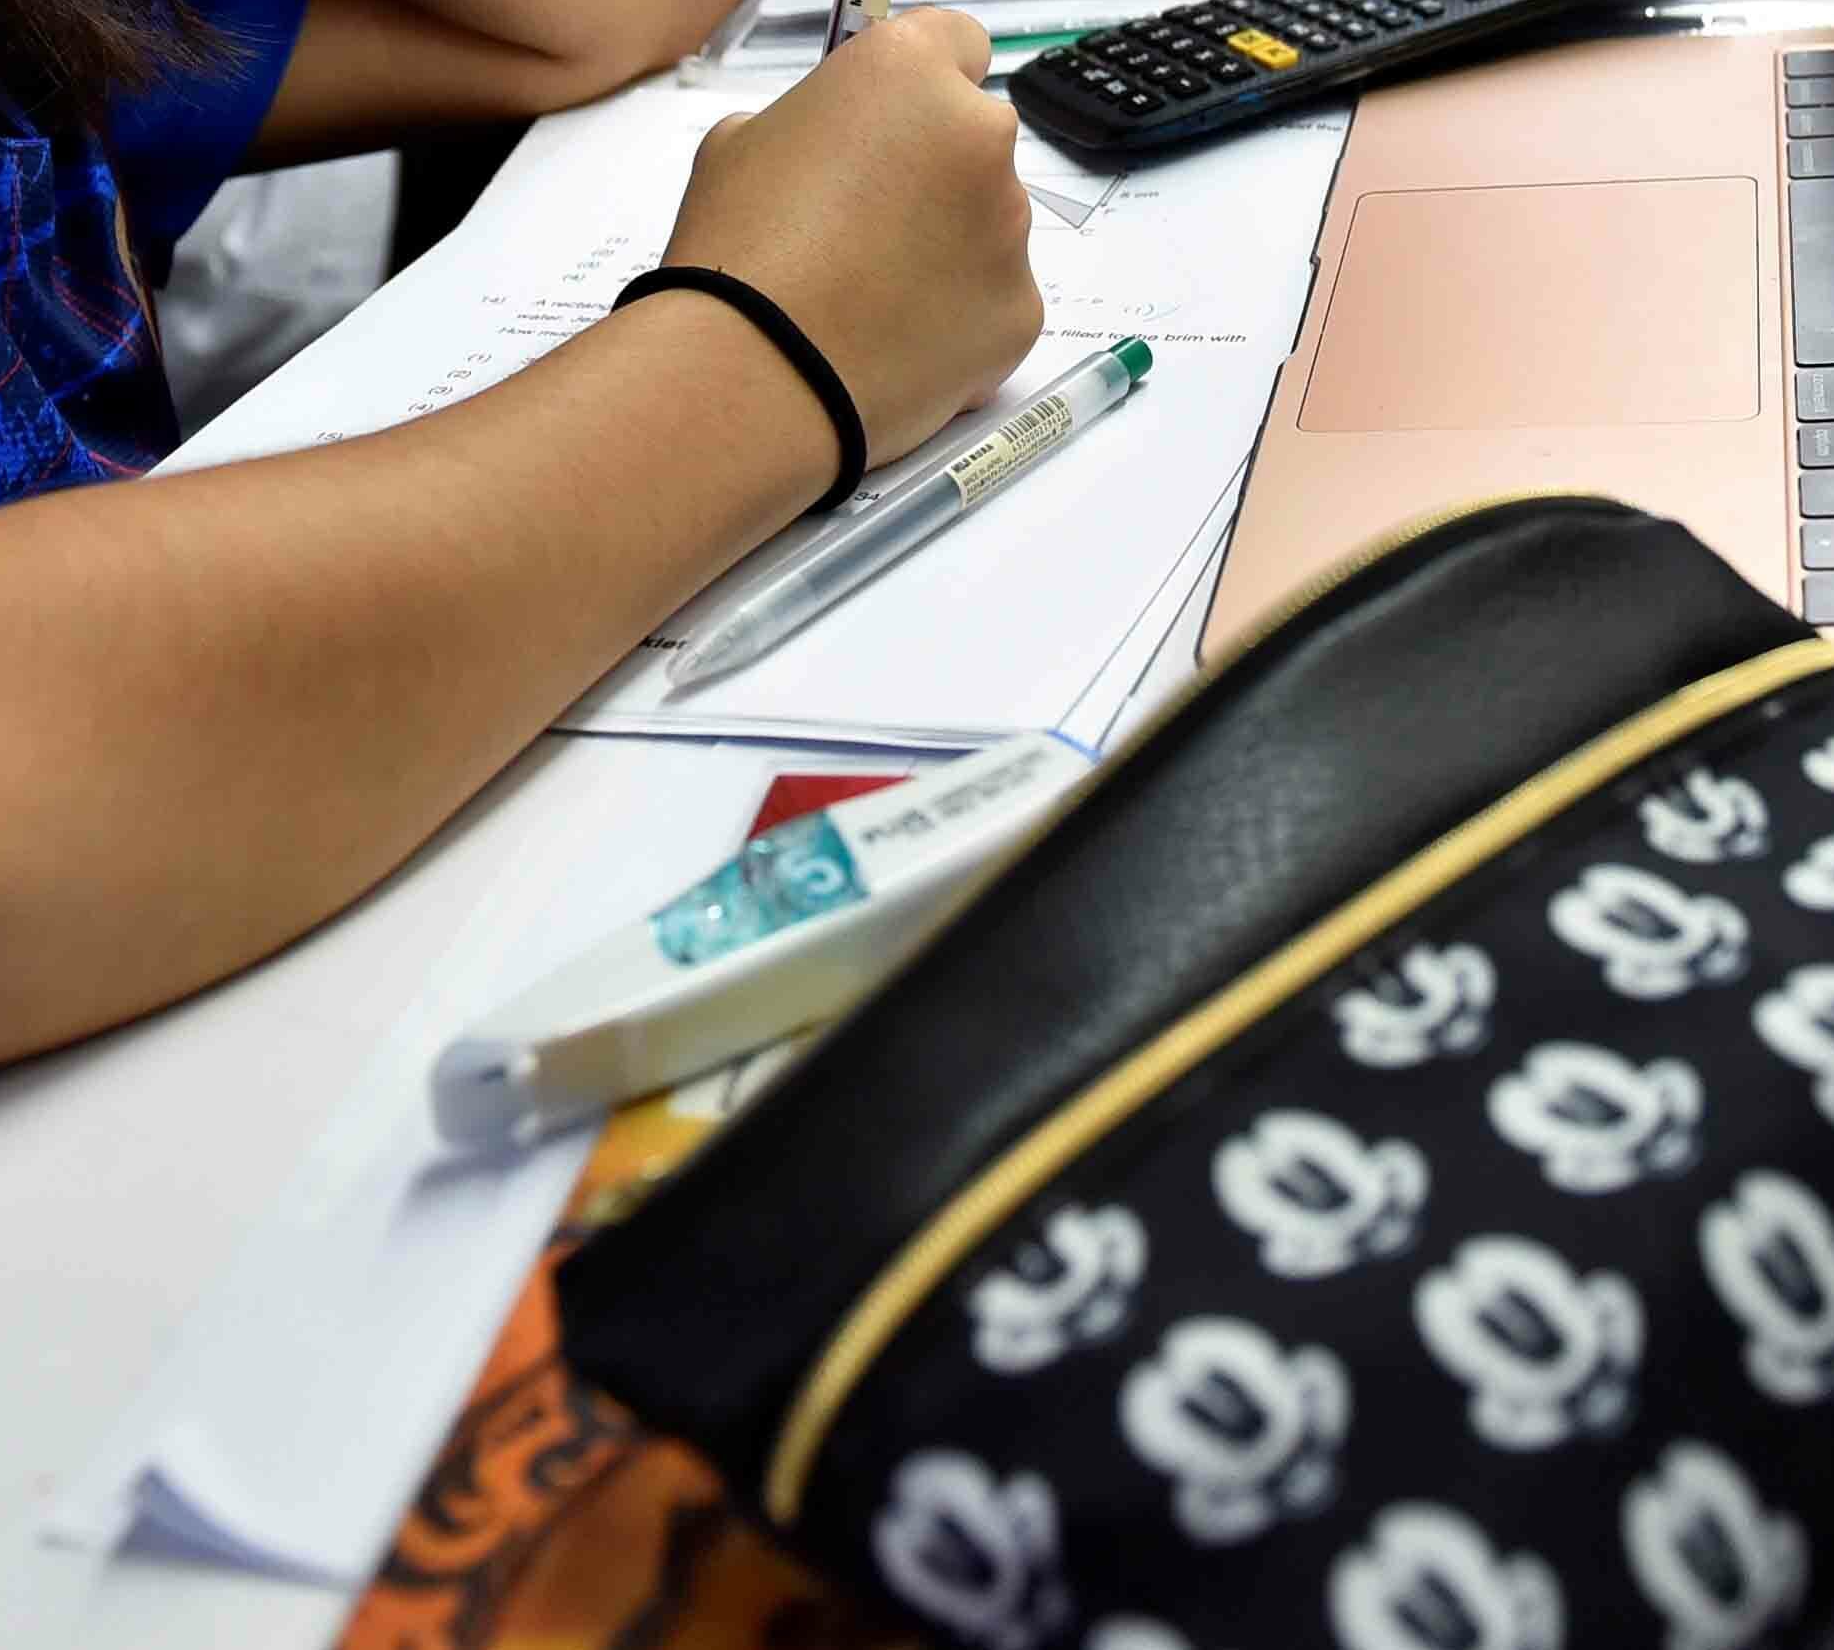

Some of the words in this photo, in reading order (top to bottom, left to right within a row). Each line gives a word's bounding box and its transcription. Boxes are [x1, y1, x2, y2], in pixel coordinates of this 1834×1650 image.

[1060, 329, 1104, 339] filled
[1108, 332, 1125, 340] to
[1164, 333, 1204, 342] brim
[1210, 334, 1247, 343] with
